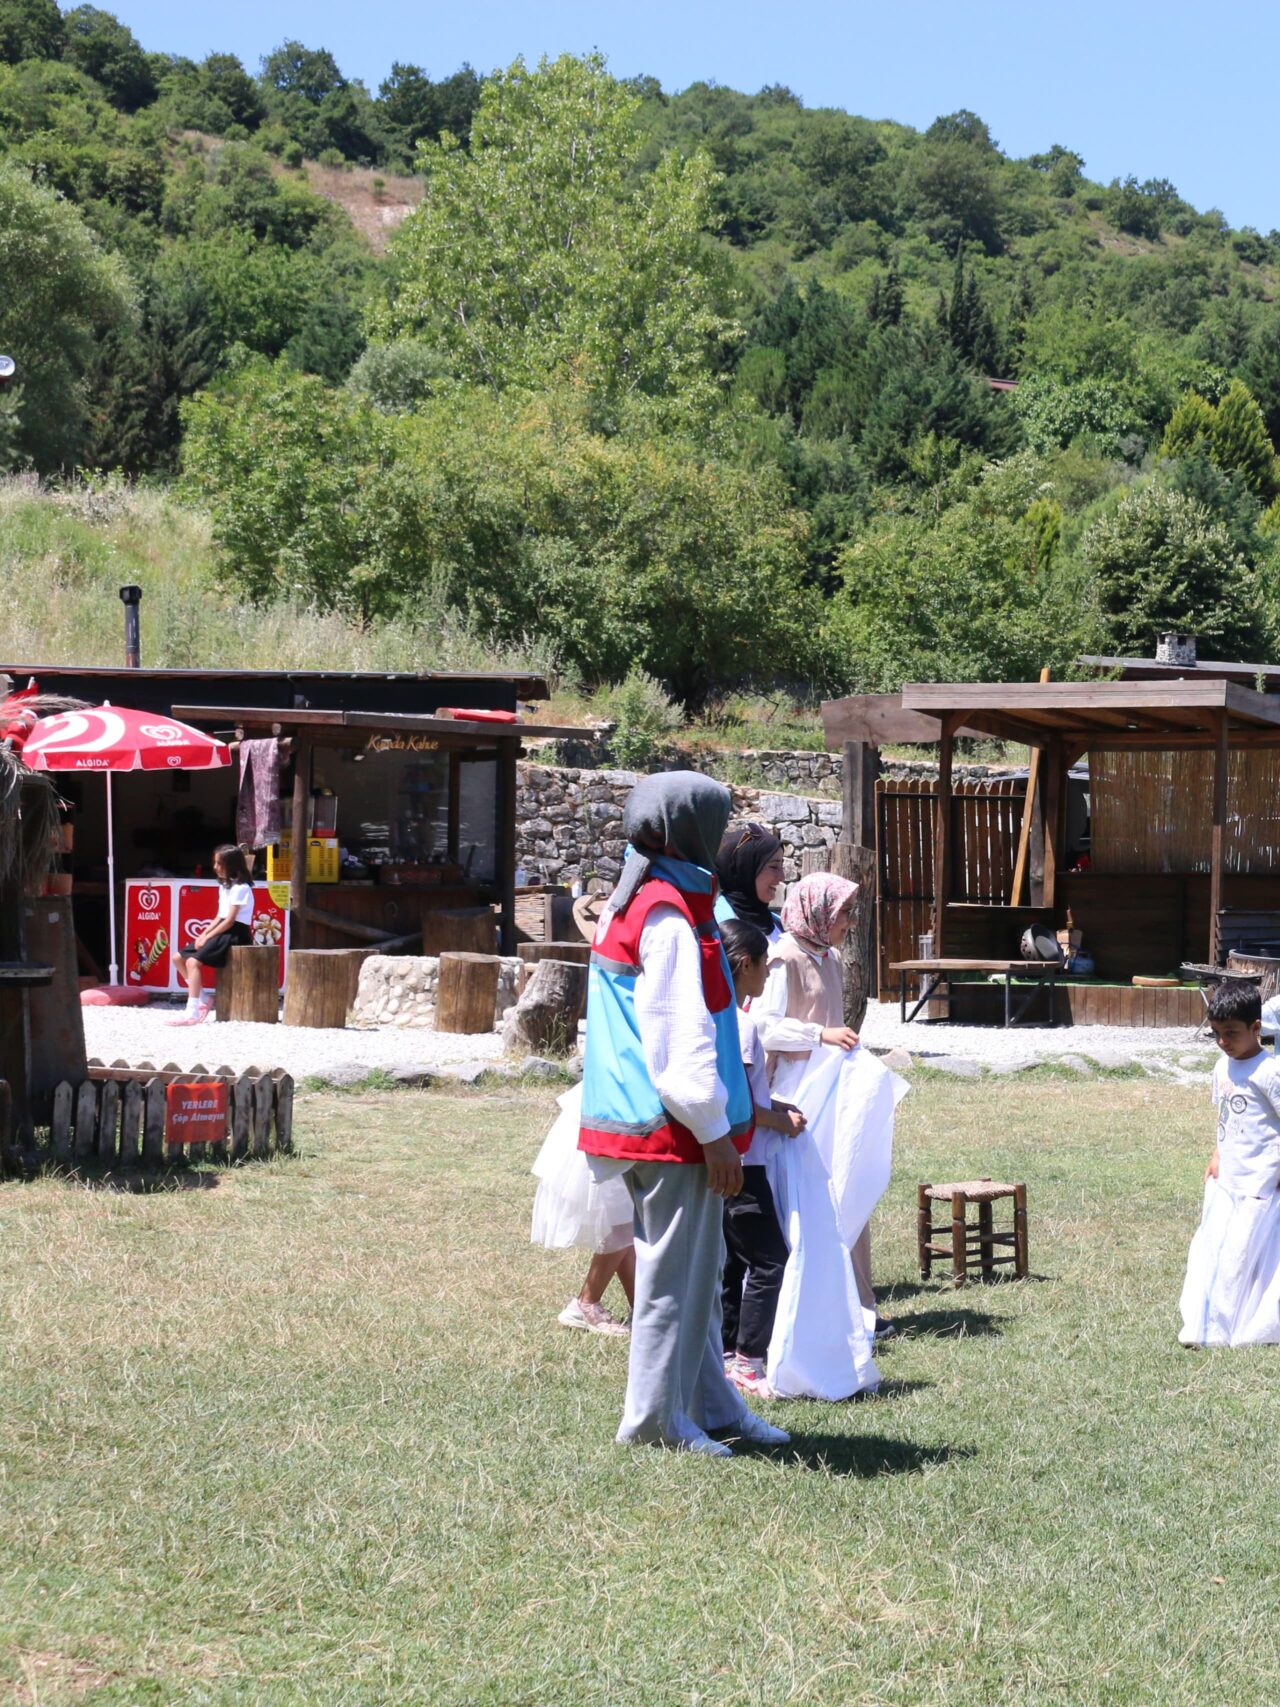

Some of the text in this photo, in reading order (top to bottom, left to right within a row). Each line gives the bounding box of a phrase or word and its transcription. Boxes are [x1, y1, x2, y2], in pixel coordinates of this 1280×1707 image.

[75, 759, 109, 767] ALGIDA
[137, 912, 160, 921] ALGIDA
[182, 1099, 218, 1109] YERLERE
[172, 1113, 225, 1125] Çöp Atmayın
